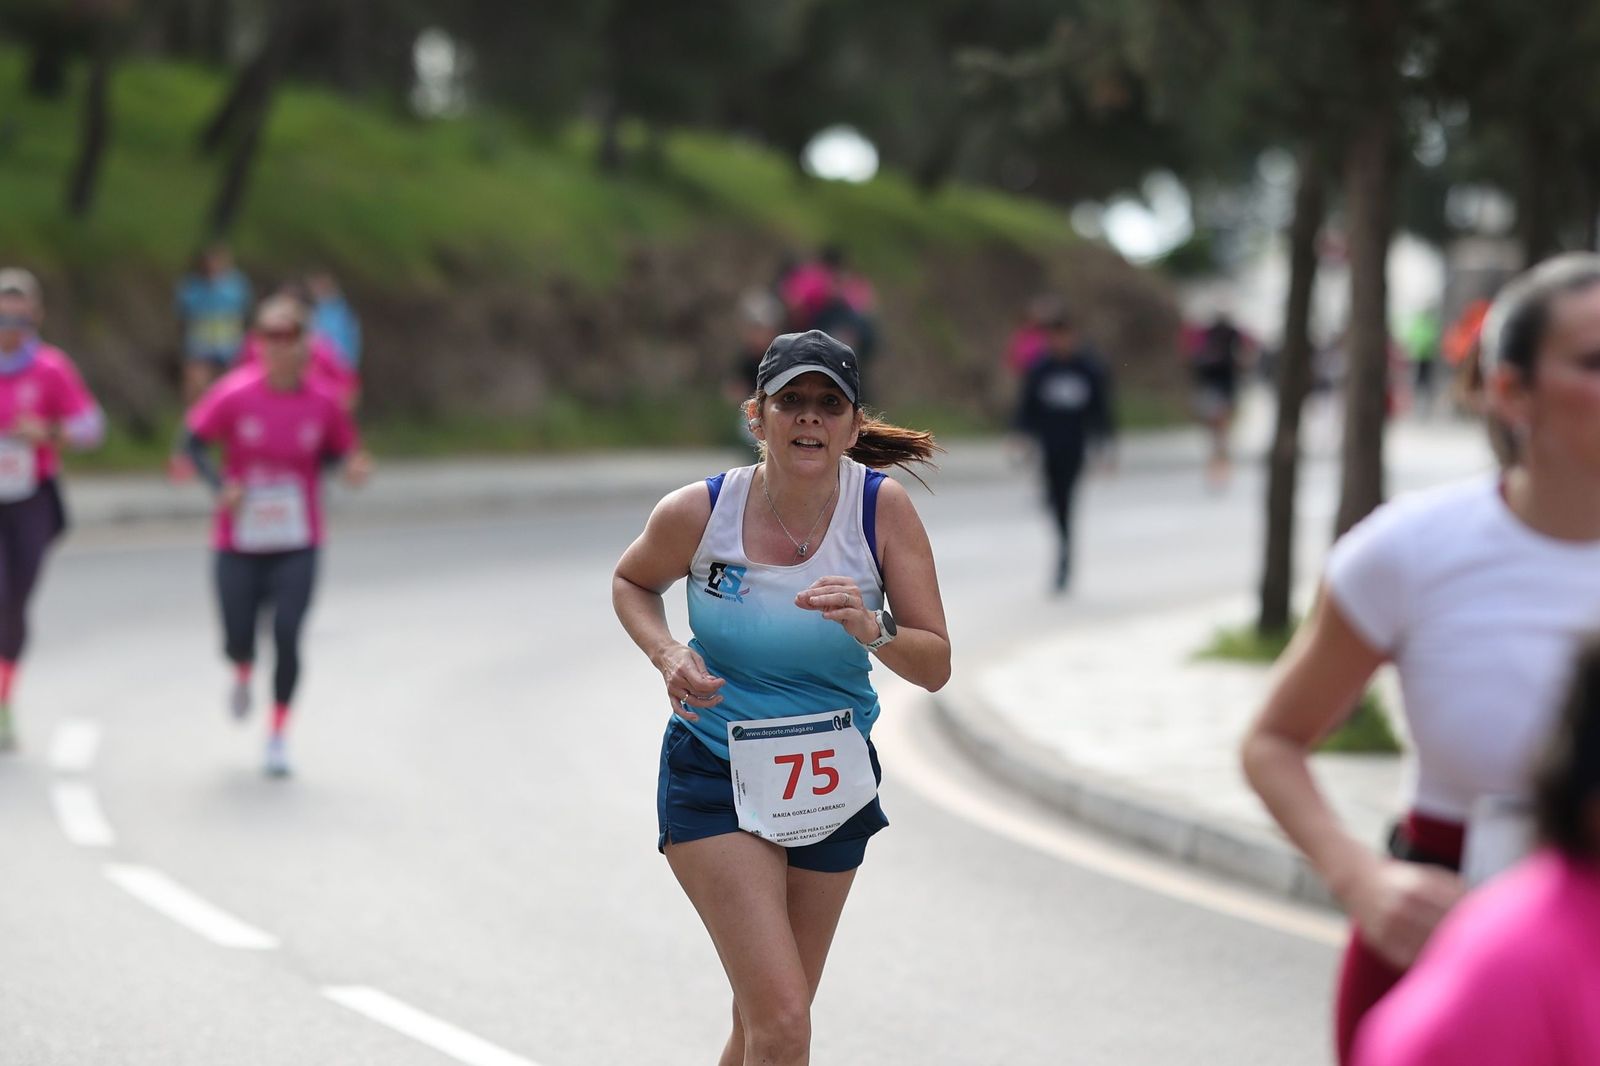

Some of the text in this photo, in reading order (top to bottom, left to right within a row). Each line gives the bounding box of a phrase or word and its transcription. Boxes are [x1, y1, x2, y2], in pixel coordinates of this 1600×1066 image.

[746, 726, 814, 737] www.deporte.malaga.eu
[774, 750, 840, 800] 75
[792, 808, 817, 816] GONZALO
[818, 803, 846, 812] CARRASCO
